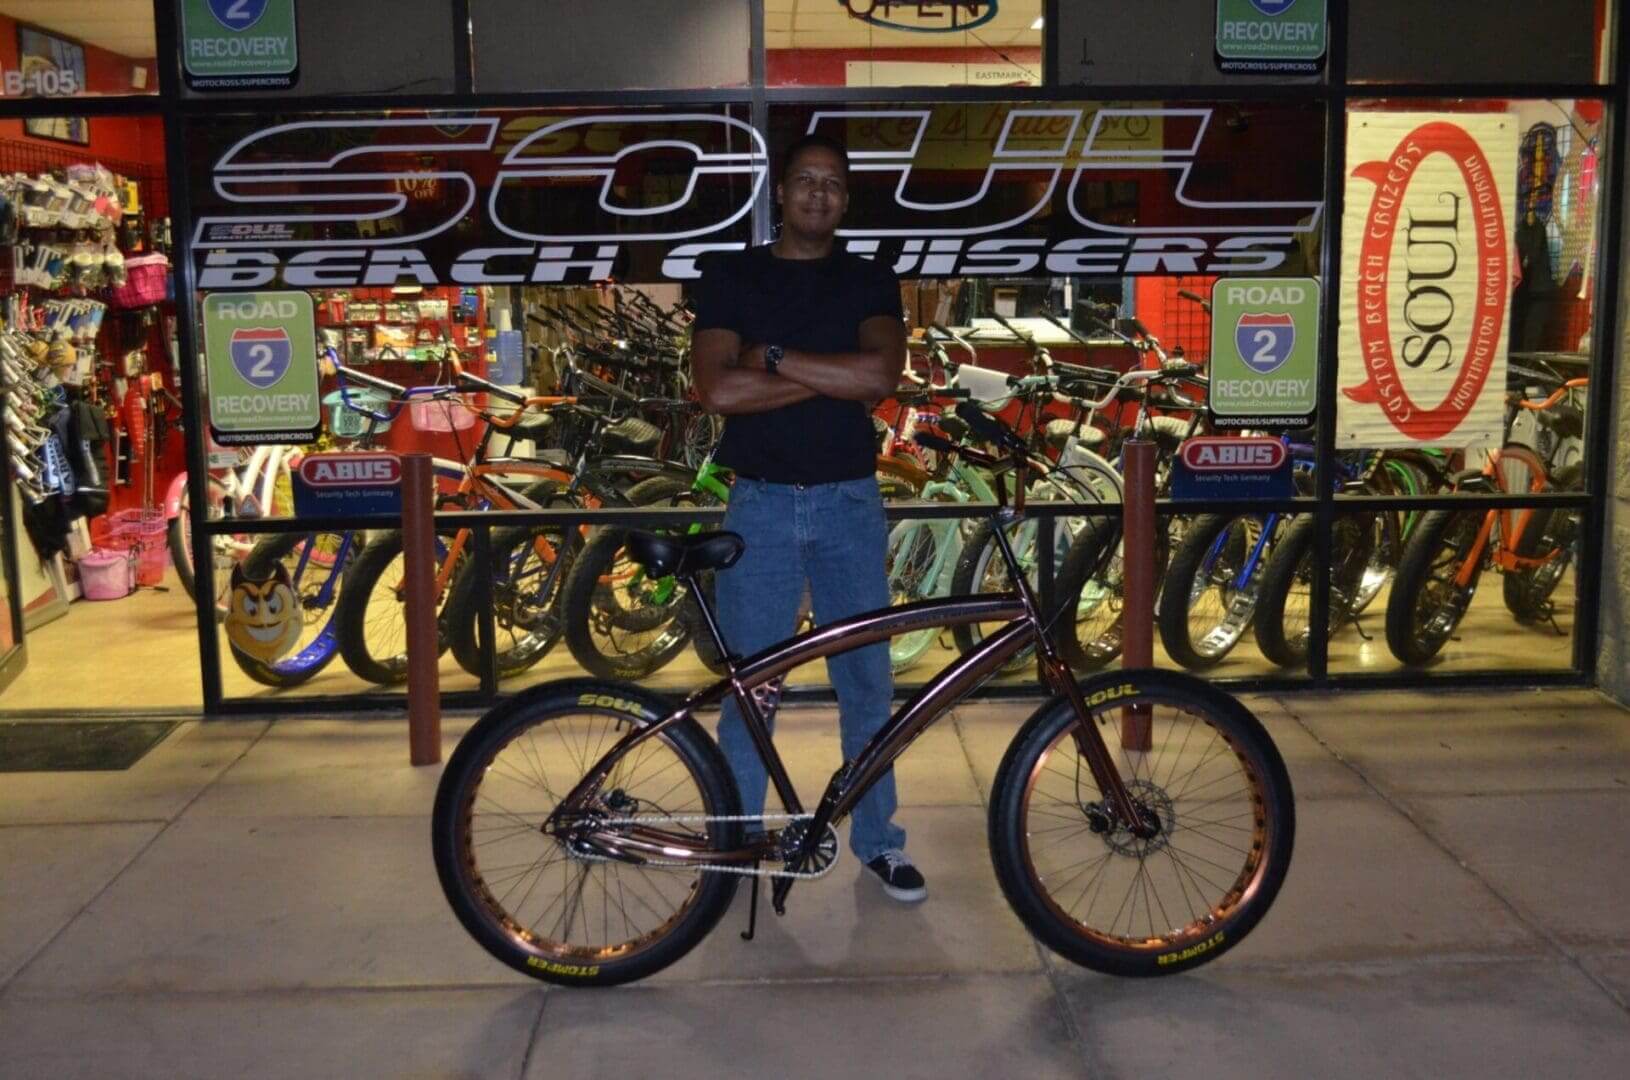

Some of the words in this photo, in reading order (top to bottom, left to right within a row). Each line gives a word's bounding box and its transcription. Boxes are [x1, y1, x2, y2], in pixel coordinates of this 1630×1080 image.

[1223, 21, 1319, 41] RECOVERY
[190, 37, 289, 57] RECOVERY
[5, 70, 75, 96] B-105
[192, 107, 1326, 250] SOUL
[1370, 141, 1422, 239] CRUZERS
[1463, 154, 1500, 249] CALIFORNIA
[198, 246, 619, 289] BEACH
[1401, 191, 1464, 373] SOUL
[1485, 256, 1501, 307] BEACH
[1227, 286, 1306, 305] ROAD
[1364, 255, 1384, 325] BEACH
[217, 300, 298, 320] ROAD
[249, 344, 275, 378] 2
[1252, 329, 1277, 363] 2
[1451, 315, 1495, 411] HUNTINGTON
[1216, 379, 1310, 398] RECOVERY
[1367, 340, 1411, 423] CUSTOM
[215, 394, 312, 414] RECOVERY
[1196, 445, 1273, 464] ABUS
[313, 461, 392, 481] ABUS
[577, 693, 659, 721] SOUL
[527, 955, 600, 976] STOMPER
